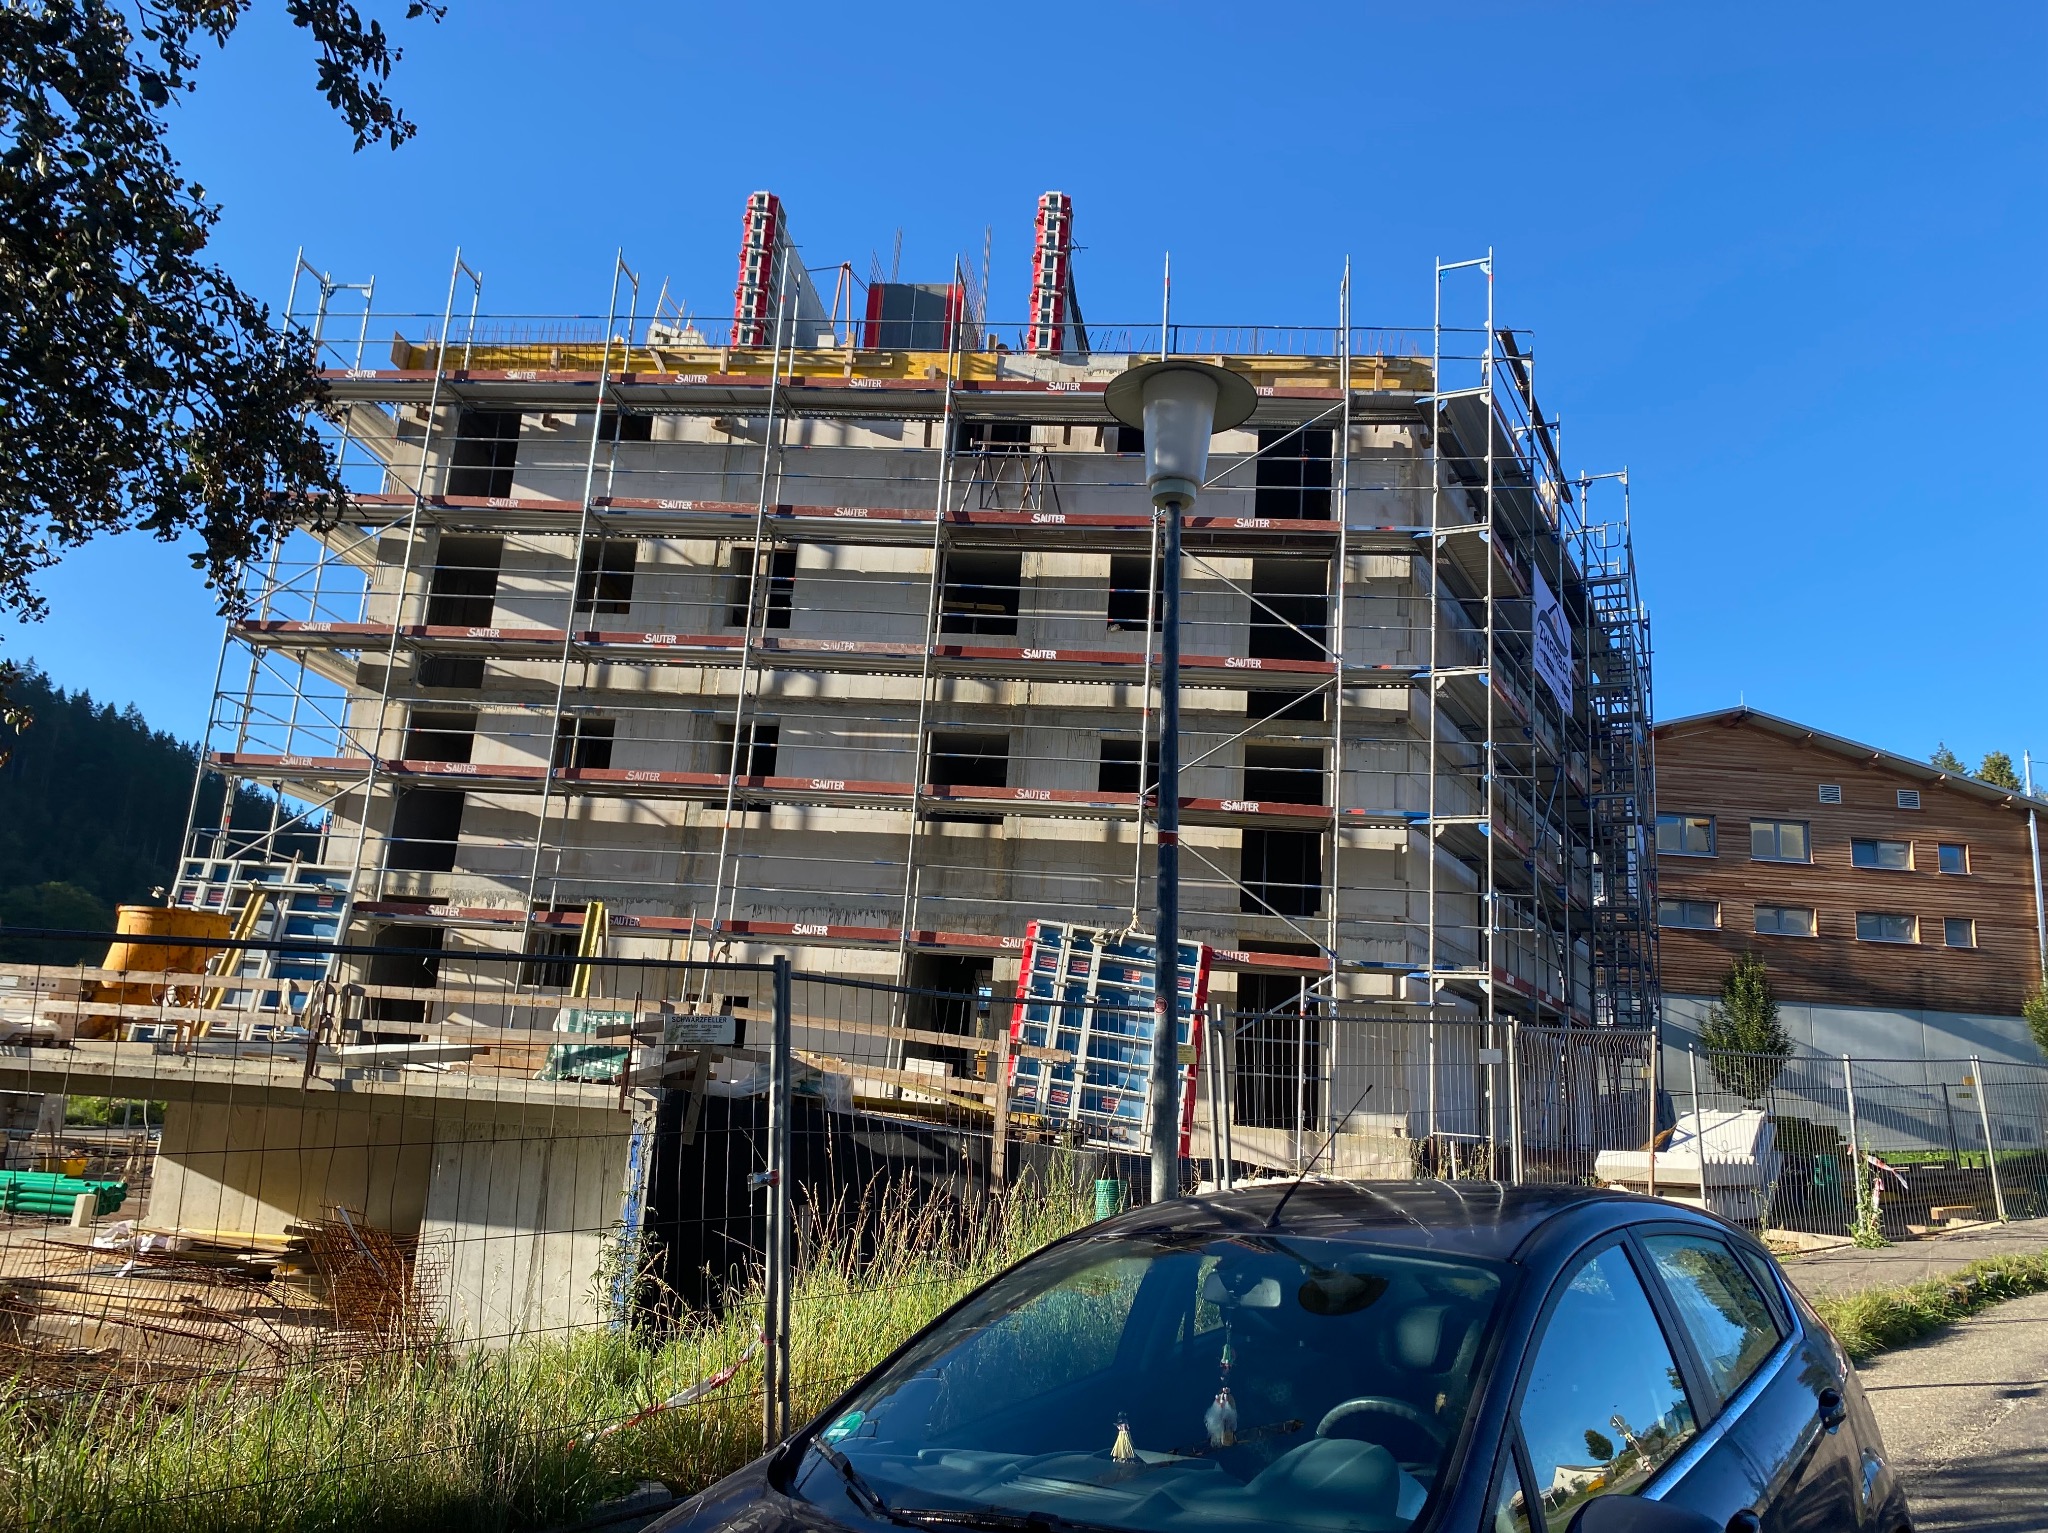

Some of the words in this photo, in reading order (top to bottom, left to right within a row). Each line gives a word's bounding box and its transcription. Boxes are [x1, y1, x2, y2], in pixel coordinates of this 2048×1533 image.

[345, 369, 376, 379] SAUTER
[505, 370, 536, 380] SAUTER
[675, 374, 708, 384] SAUTER
[849, 378, 882, 388] SAUTER
[1046, 381, 1080, 391] SAUTER
[487, 498, 518, 508] SAUTER
[659, 500, 692, 510] SAUTER
[834, 507, 868, 517] SAUTER
[1031, 514, 1065, 524] SAUTER
[1234, 518, 1270, 528] SAUTER
[299, 622, 331, 632] SAUTER
[467, 627, 500, 637] SAUTER
[643, 633, 677, 644] SAUTER
[821, 641, 854, 650] SAUTER
[1021, 649, 1056, 659] SAUTER
[1226, 658, 1262, 669] SAUTER
[280, 756, 313, 766] SAUTER
[443, 763, 477, 773] SAUTER
[625, 770, 660, 781] SAUTER
[810, 779, 845, 790] SAUTER
[1015, 788, 1051, 800] SAUTER
[1221, 801, 1259, 812] SAUTER
[426, 904, 460, 916] SAUTER
[610, 915, 640, 926] SAUTER
[792, 923, 828, 935] SAUTER
[1000, 936, 1026, 949] SAUT
[1212, 950, 1249, 962] SAUTER
